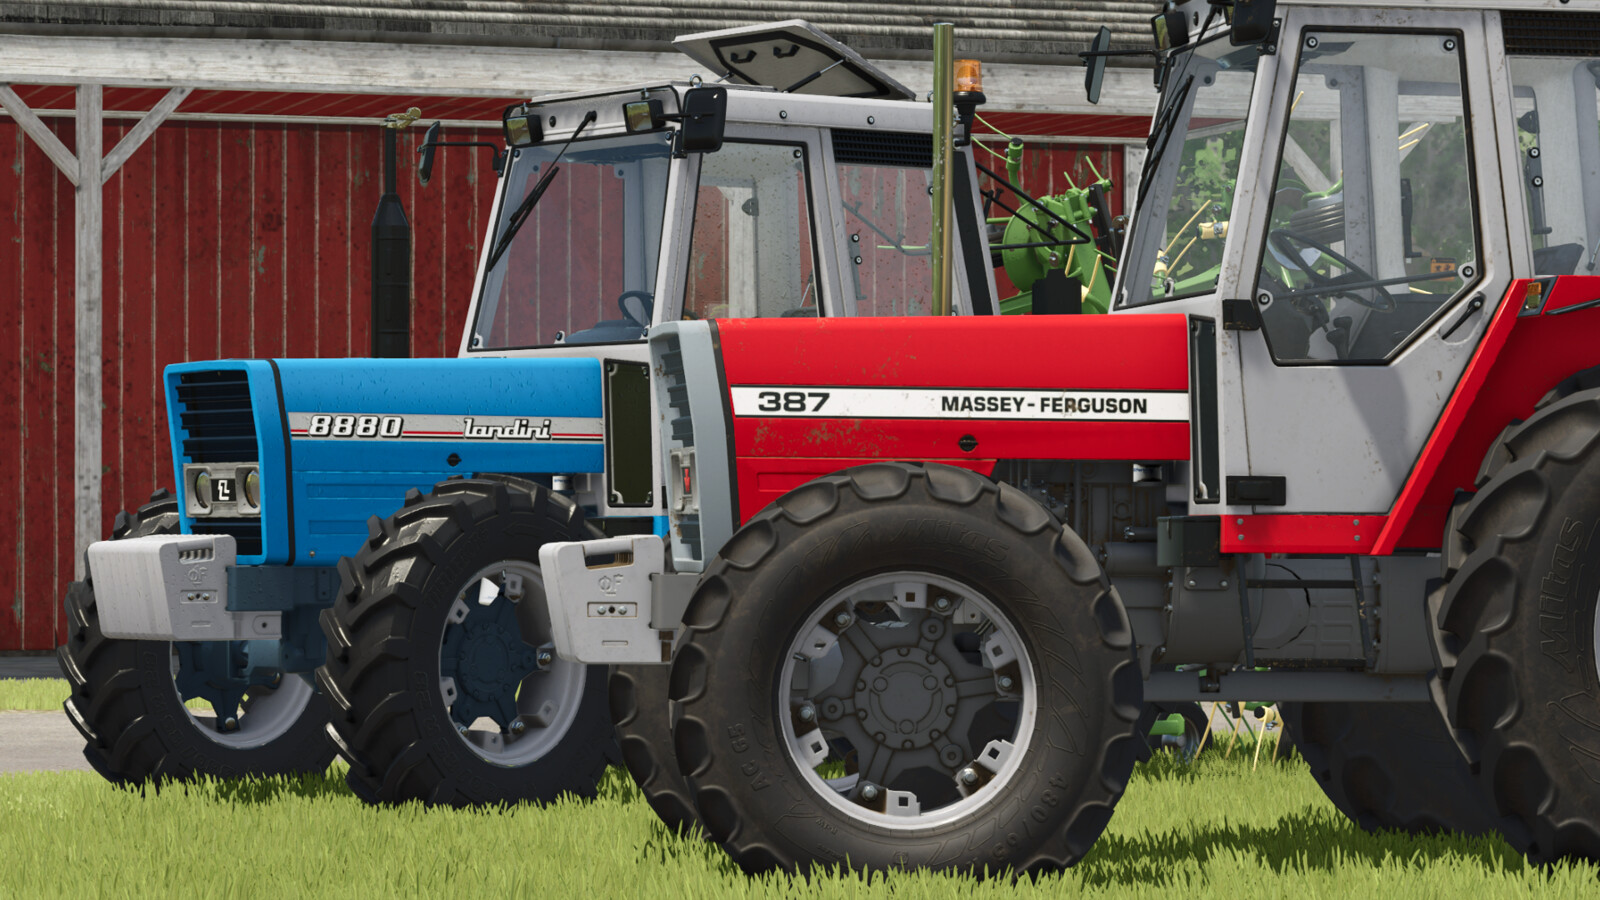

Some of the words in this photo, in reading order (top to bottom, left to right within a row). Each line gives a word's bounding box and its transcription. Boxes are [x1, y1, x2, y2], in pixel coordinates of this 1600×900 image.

[757, 391, 830, 412] 387
[941, 396, 1148, 415] MASSEY-FERGUSON
[308, 415, 404, 438] 8880
[464, 417, 552, 440] landini
[889, 518, 1010, 562] Mitas
[1538, 516, 1586, 674] Mitas
